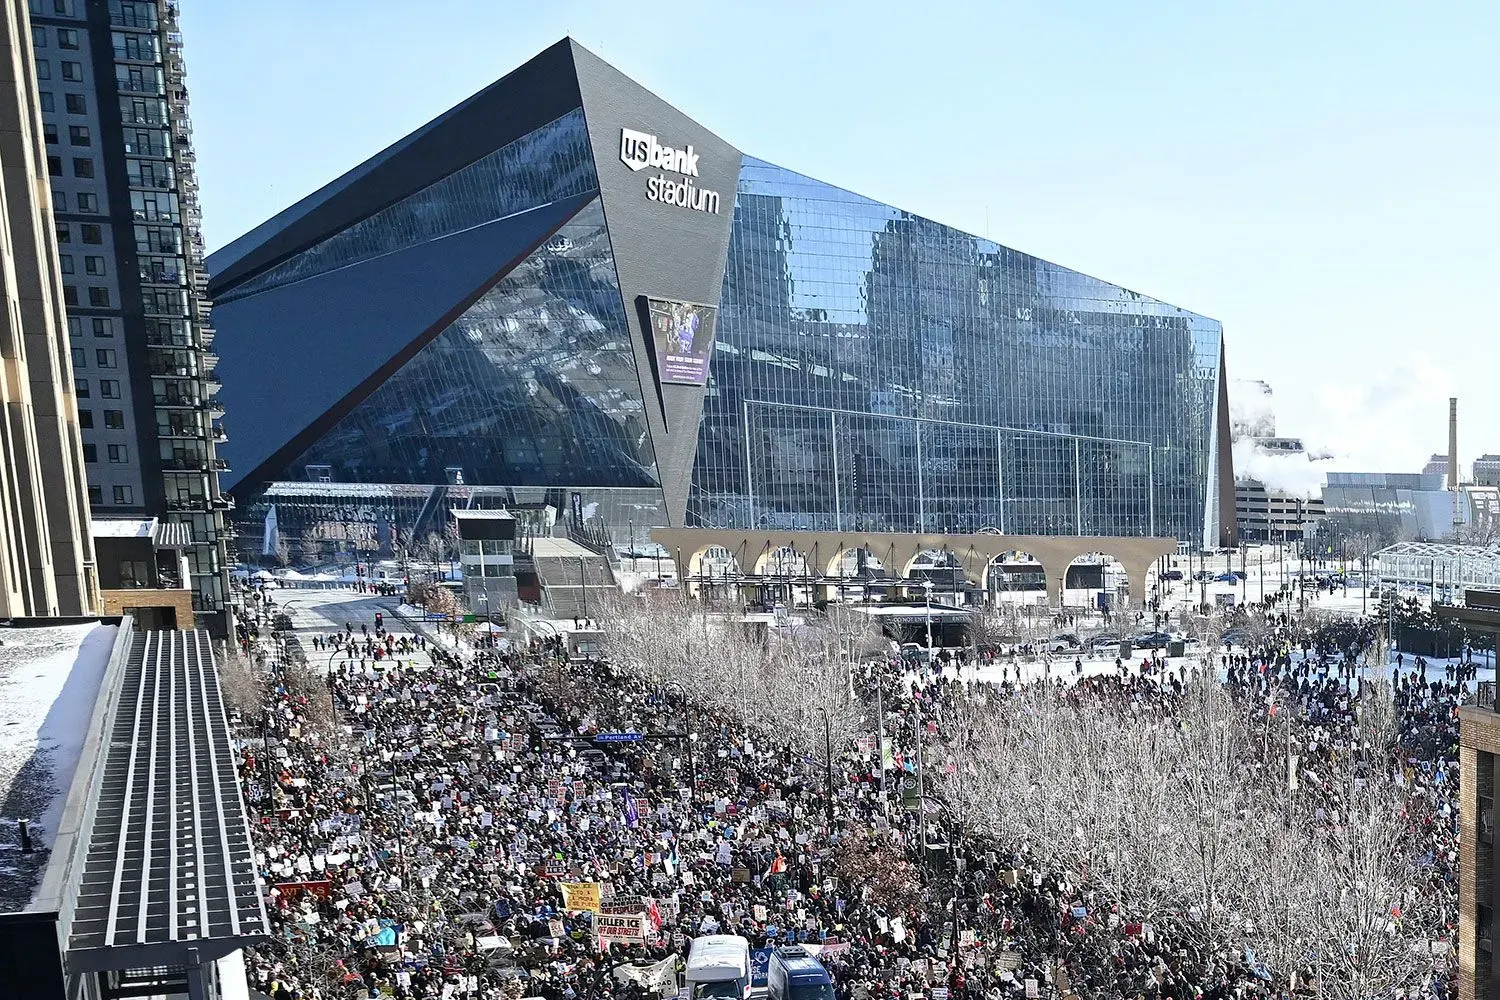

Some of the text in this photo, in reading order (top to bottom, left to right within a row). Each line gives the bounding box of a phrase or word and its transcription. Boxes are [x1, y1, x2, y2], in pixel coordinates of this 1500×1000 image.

[645, 173, 720, 214] stadium
[597, 917, 640, 928] KILLER ICE
[608, 927, 618, 935] OUR
